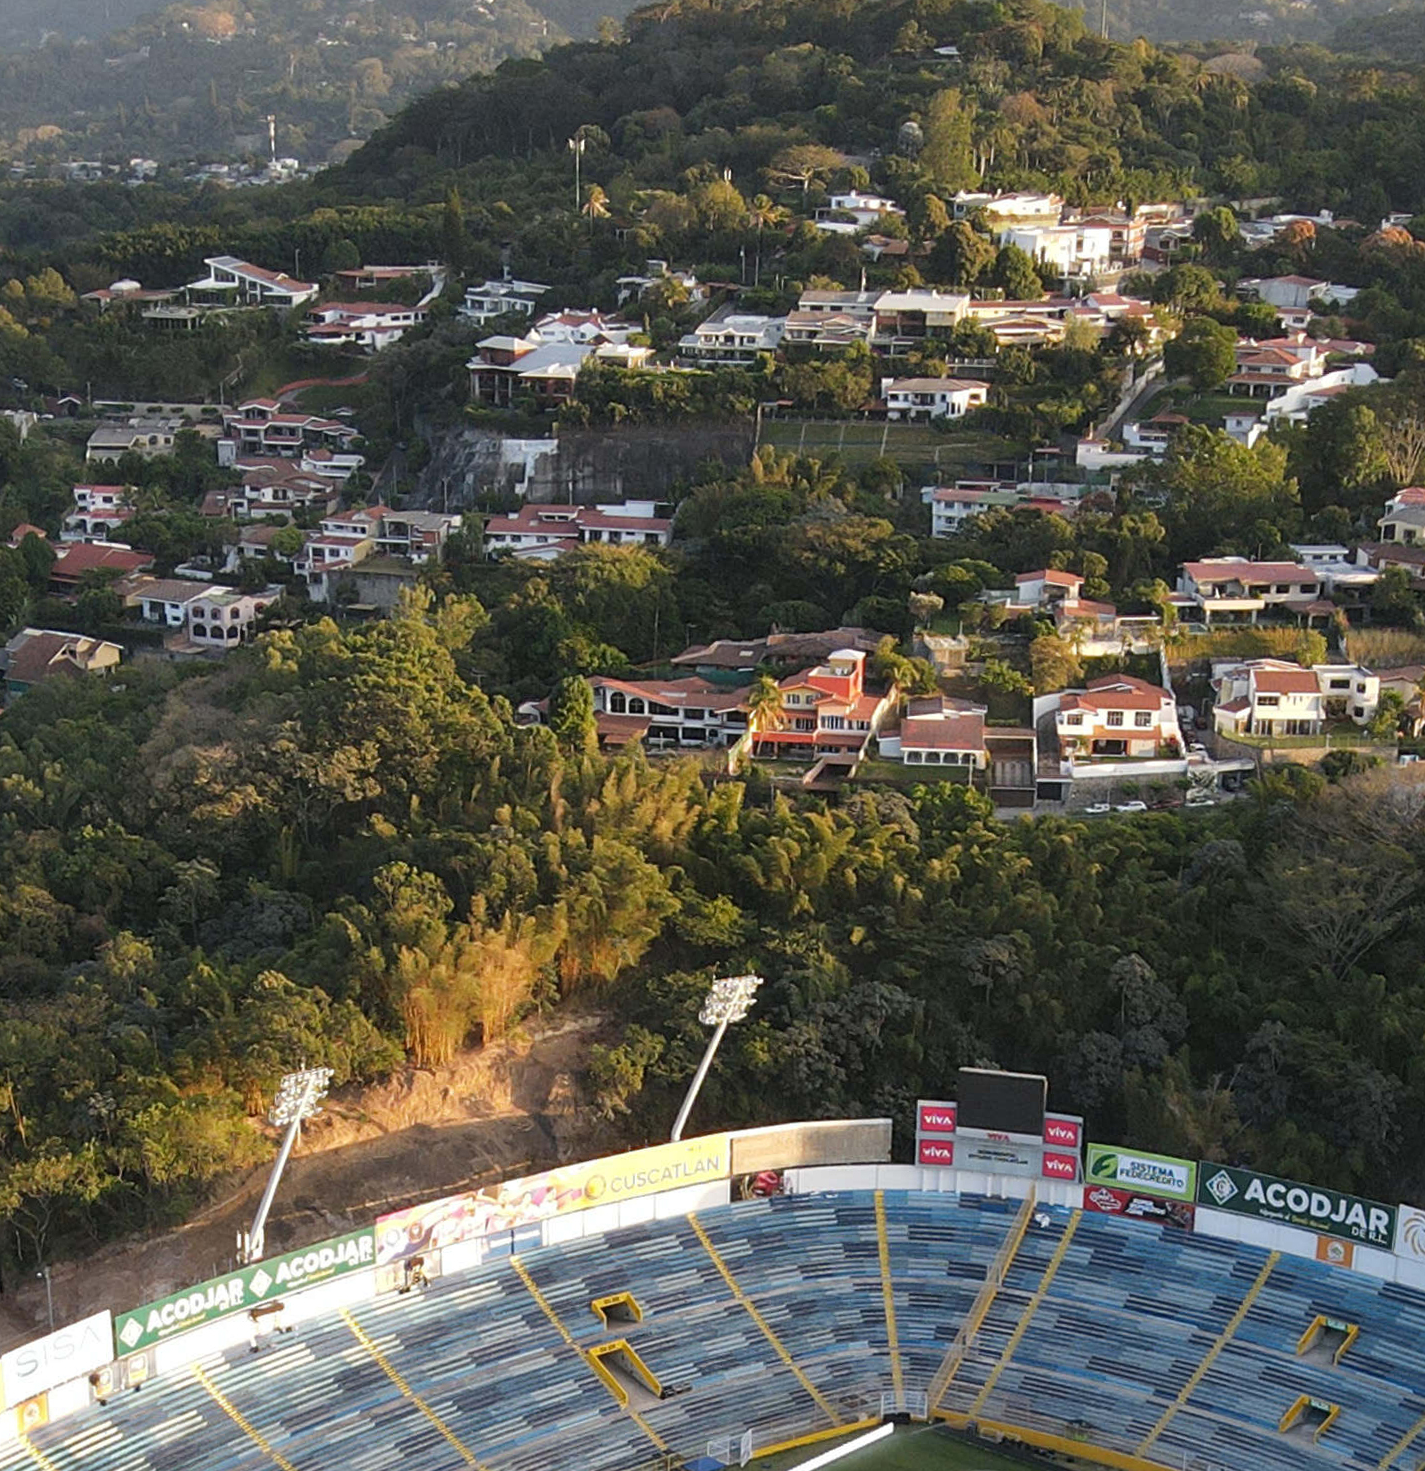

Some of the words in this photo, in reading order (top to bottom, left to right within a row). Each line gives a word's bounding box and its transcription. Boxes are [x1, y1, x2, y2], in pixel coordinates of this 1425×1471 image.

[610, 1154, 720, 1194] CUSCATLAN
[1130, 1161, 1174, 1178] SISTEMA
[1244, 1178, 1389, 1236] ACODJAR
[275, 1235, 374, 1285] ACODJAR
[146, 1278, 245, 1333] ACODJAR
